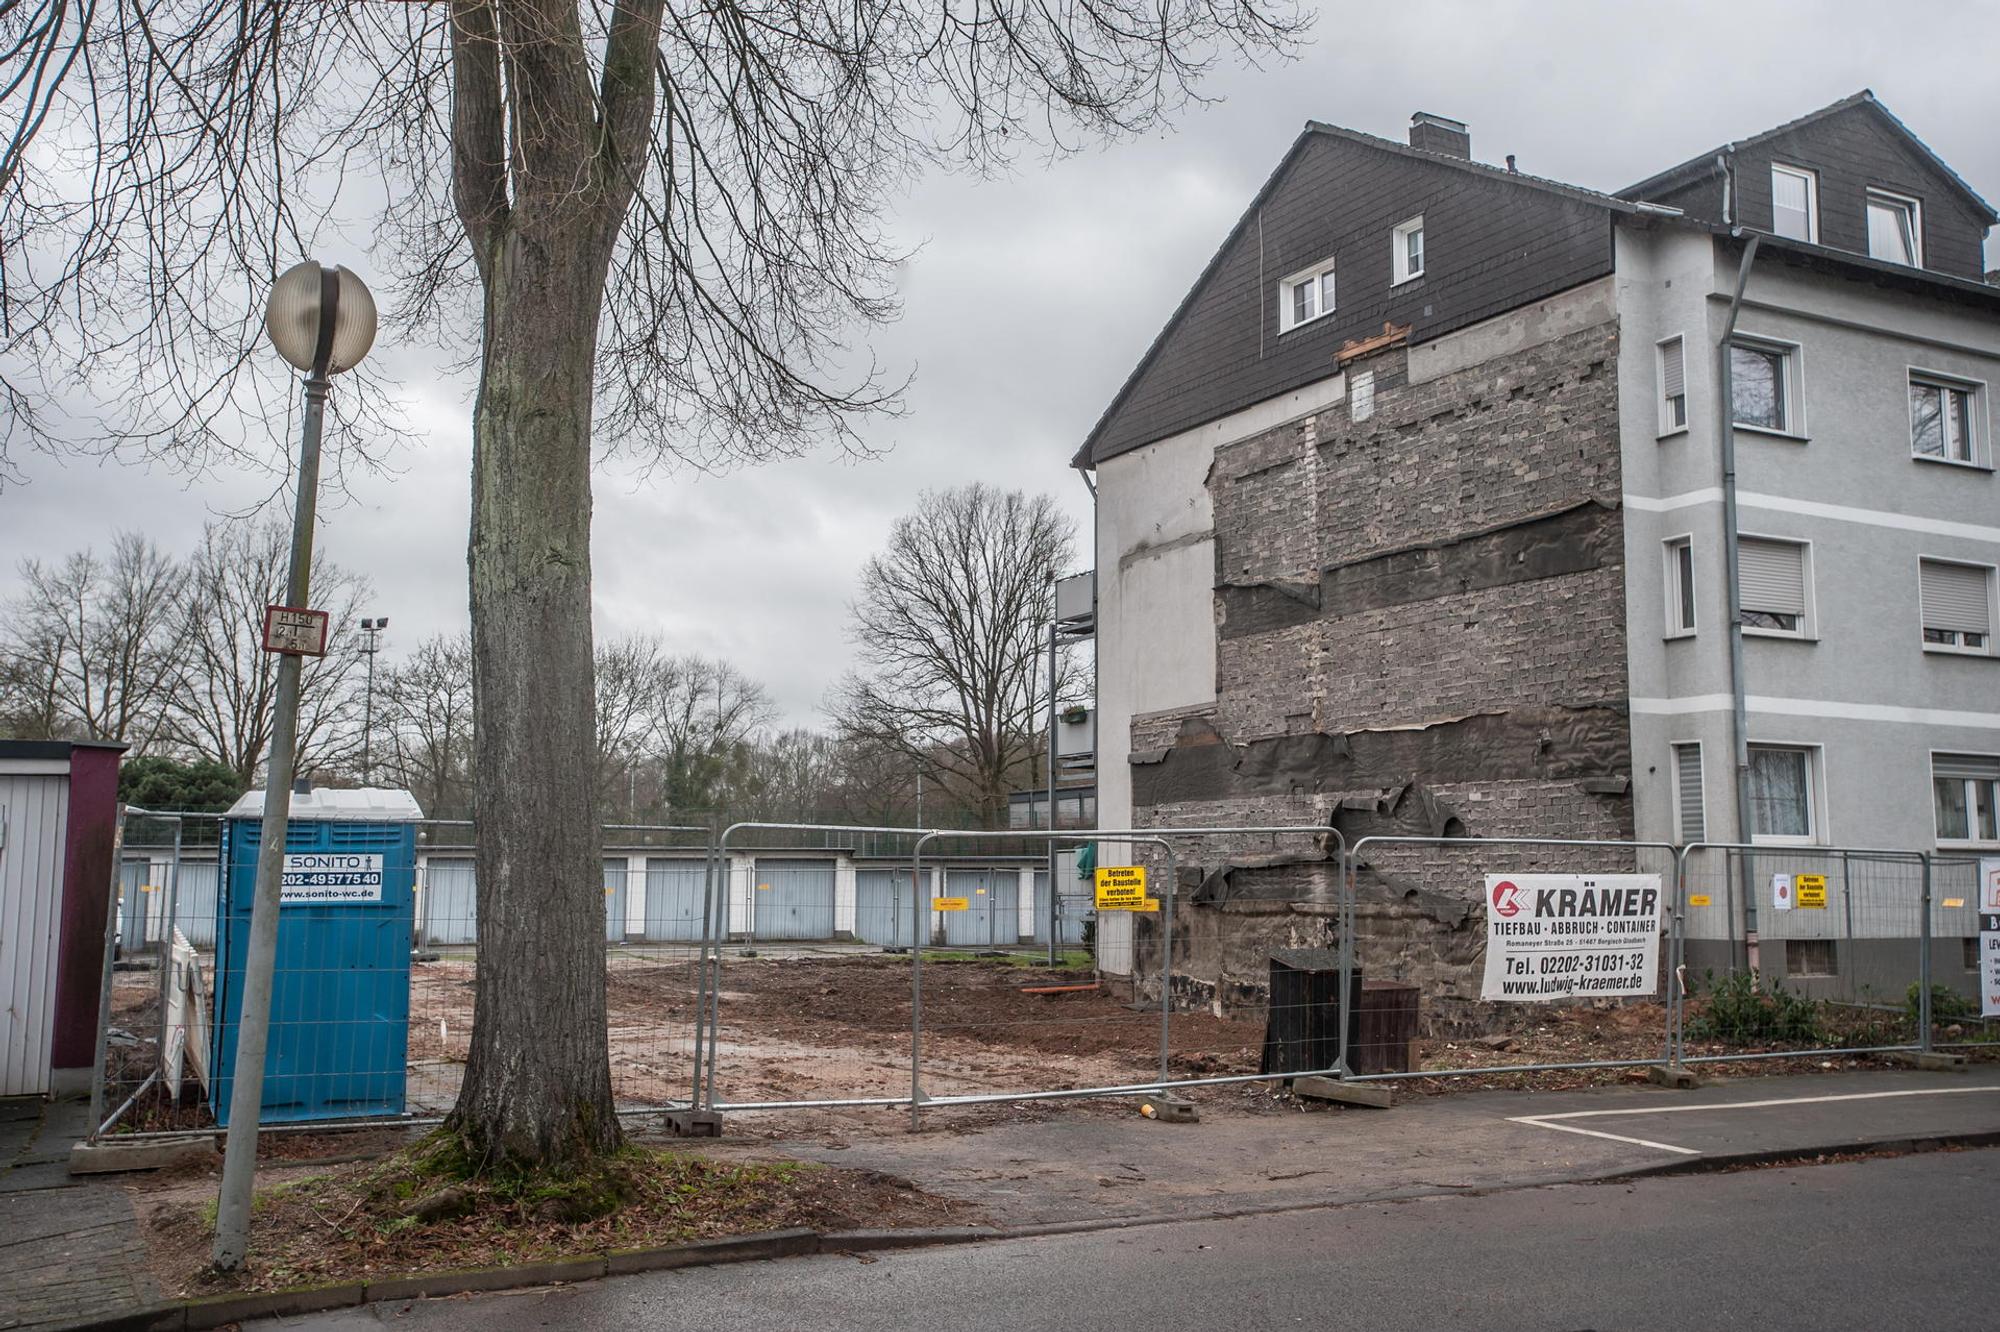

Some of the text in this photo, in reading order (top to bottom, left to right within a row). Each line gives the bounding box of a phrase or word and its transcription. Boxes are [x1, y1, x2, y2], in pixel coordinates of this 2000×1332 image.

[291, 857, 360, 868] SONITO
[1108, 869, 1135, 877] Betreten
[1100, 879, 1111, 887] der
[1535, 881, 1658, 918] KRÄMER
[1494, 919, 1656, 936] TIEFBAU ABBRUCH CONTAINER
[1506, 940, 1543, 948] Romaneyer
[1506, 953, 1644, 975] Tel. 02202-31031-32
[1503, 974, 1642, 995] www.ludwig-kraemer.de
